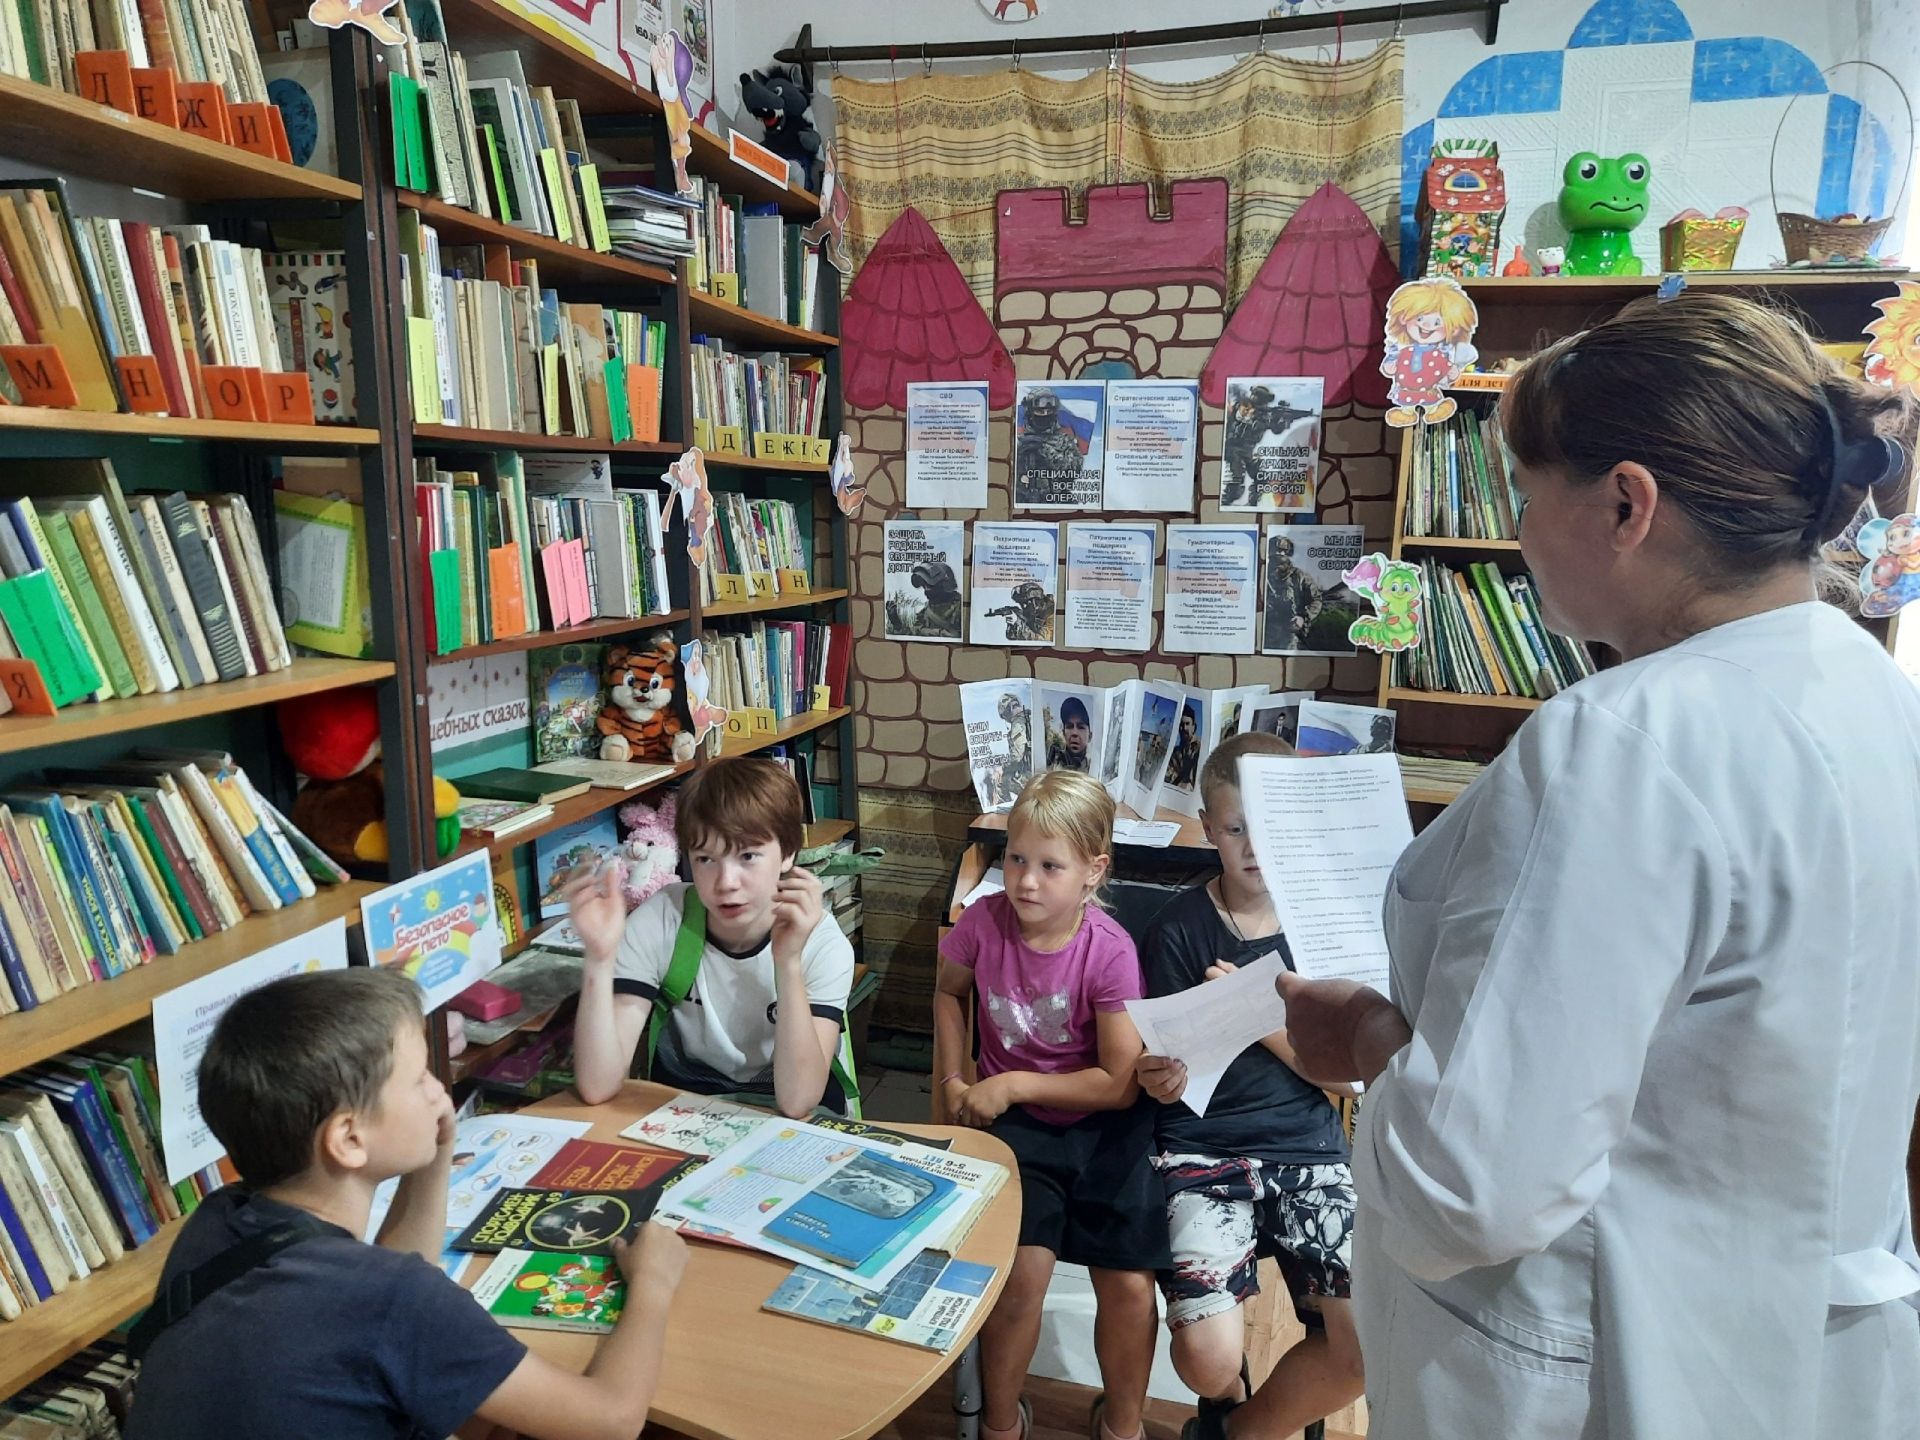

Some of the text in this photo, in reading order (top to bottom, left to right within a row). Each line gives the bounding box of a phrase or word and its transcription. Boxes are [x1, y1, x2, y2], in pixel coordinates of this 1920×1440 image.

[92, 72, 113, 106] Д
[137, 86, 156, 117] Е
[181, 99, 207, 129] Ж
[238, 116, 259, 144] И
[716, 281, 726, 298] Б
[225, 287, 246, 342] ПЕТУХОВ
[16, 360, 56, 390] М
[128, 368, 152, 397] Н
[1458, 380, 1480, 388] для
[219, 379, 241, 406] О
[279, 385, 295, 410] Р
[722, 434, 735, 450] Д
[765, 440, 775, 453] Е
[783, 441, 795, 454] Ж
[1258, 447, 1309, 457] СИЛЬНАЯ
[1259, 459, 1297, 469] АРМИЯ
[1027, 470, 1100, 479] СПЕЦИАЛЬНАЯ
[1256, 471, 1307, 480] СИЛЬНАЯ
[1053, 482, 1100, 491] ВОЕННАЯ
[1257, 484, 1305, 494] РОССИЯ!
[1045, 494, 1099, 503] ОПЕРАЦИЯ
[889, 530, 925, 539] ЗАЩИТА
[1325, 536, 1362, 545] МЫ НЕ
[889, 541, 927, 551] РОДИНЫ
[888, 552, 946, 563] СВЯЩЕННЫЙ
[1308, 548, 1362, 558] ОСТАВИМ
[726, 581, 737, 594] Л
[753, 579, 766, 591] М
[794, 576, 804, 588] Н
[12, 673, 31, 699] Я
[483, 701, 527, 726] сказок
[729, 719, 741, 732] О
[757, 717, 767, 729] П
[968, 721, 989, 733] НАШИ
[969, 731, 1002, 745] СОЛДАТЫ
[971, 745, 992, 757] НАША
[76, 875, 122, 968] ТРОЯНСКАЯ ВОЙНА
[396, 904, 469, 947] Безопасное
[420, 930, 449, 955] лето
[195, 990, 238, 1018] Правила
[899, 1155, 933, 1168] ДЕТЬМИ
[922, 1154, 967, 1169] 5-6 ЛЕТ
[943, 1166, 982, 1178] ЗАНЯТИЯ
[488, 1193, 543, 1244] ПОДВОДНИК
